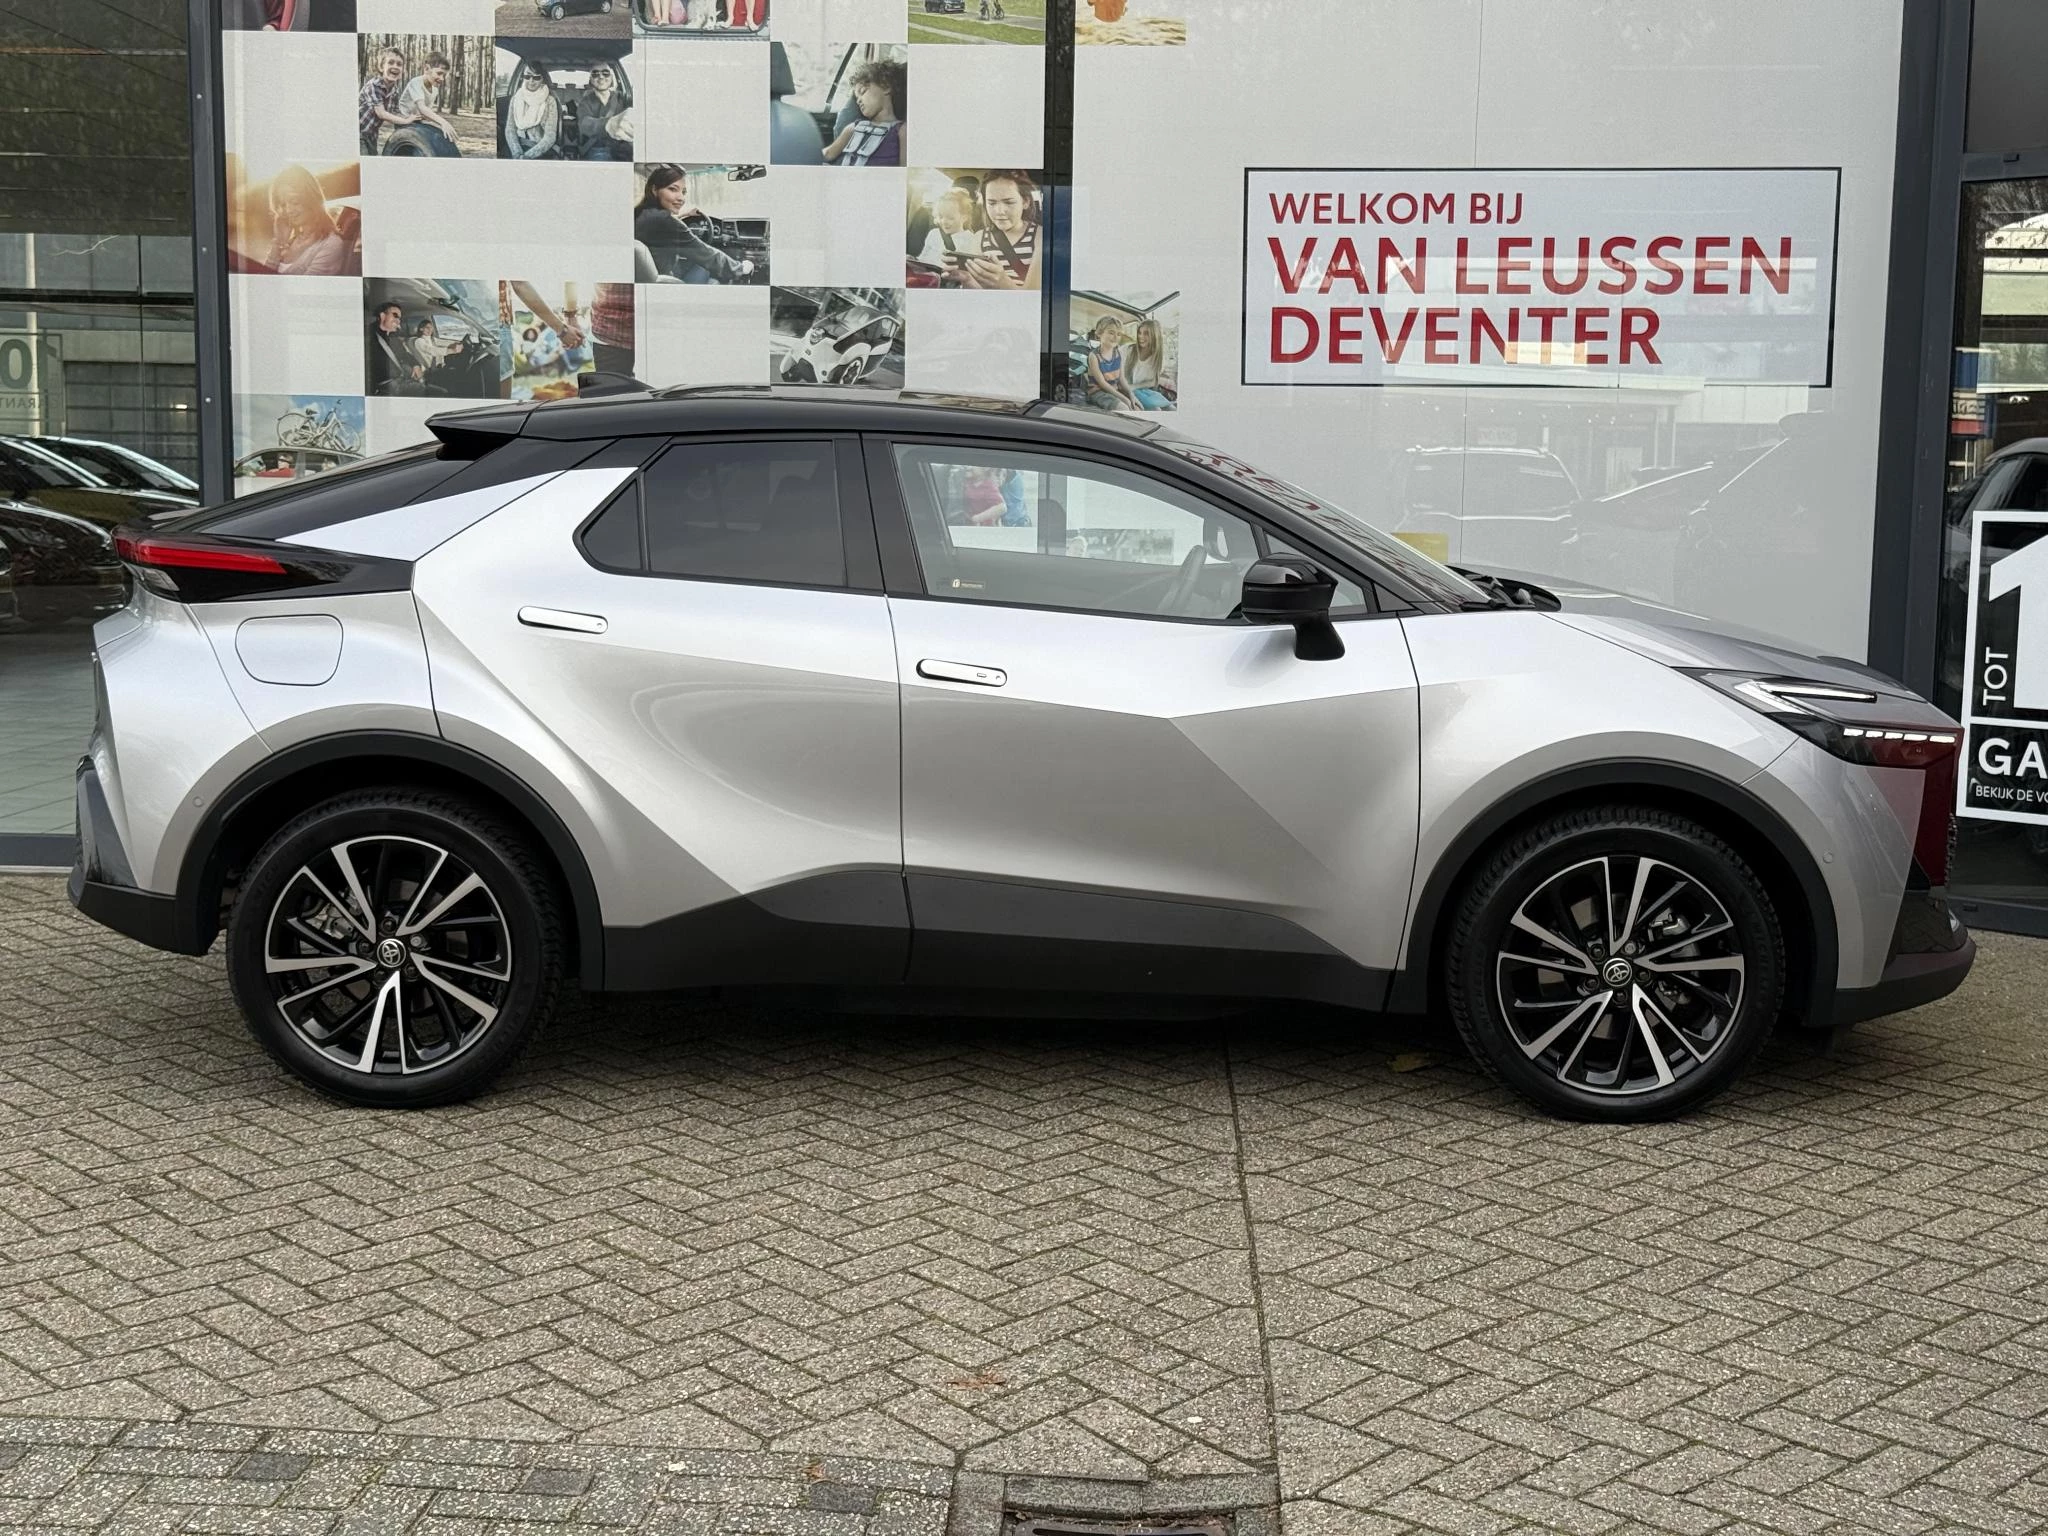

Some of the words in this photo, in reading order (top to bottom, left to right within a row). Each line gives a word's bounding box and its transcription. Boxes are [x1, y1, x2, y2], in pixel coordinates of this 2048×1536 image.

[1269, 192, 1455, 225] WELKOM
[1469, 193, 1524, 225] BIJ
[1267, 236, 1427, 295] VAN
[1455, 236, 1792, 295] LEUSSEN
[1271, 306, 1663, 365] DEVENTER
[1983, 646, 2008, 706] TOT
[1978, 737, 2048, 779] GA
[1975, 785, 2014, 800] BEKIJK
[2016, 788, 2034, 802] DE
